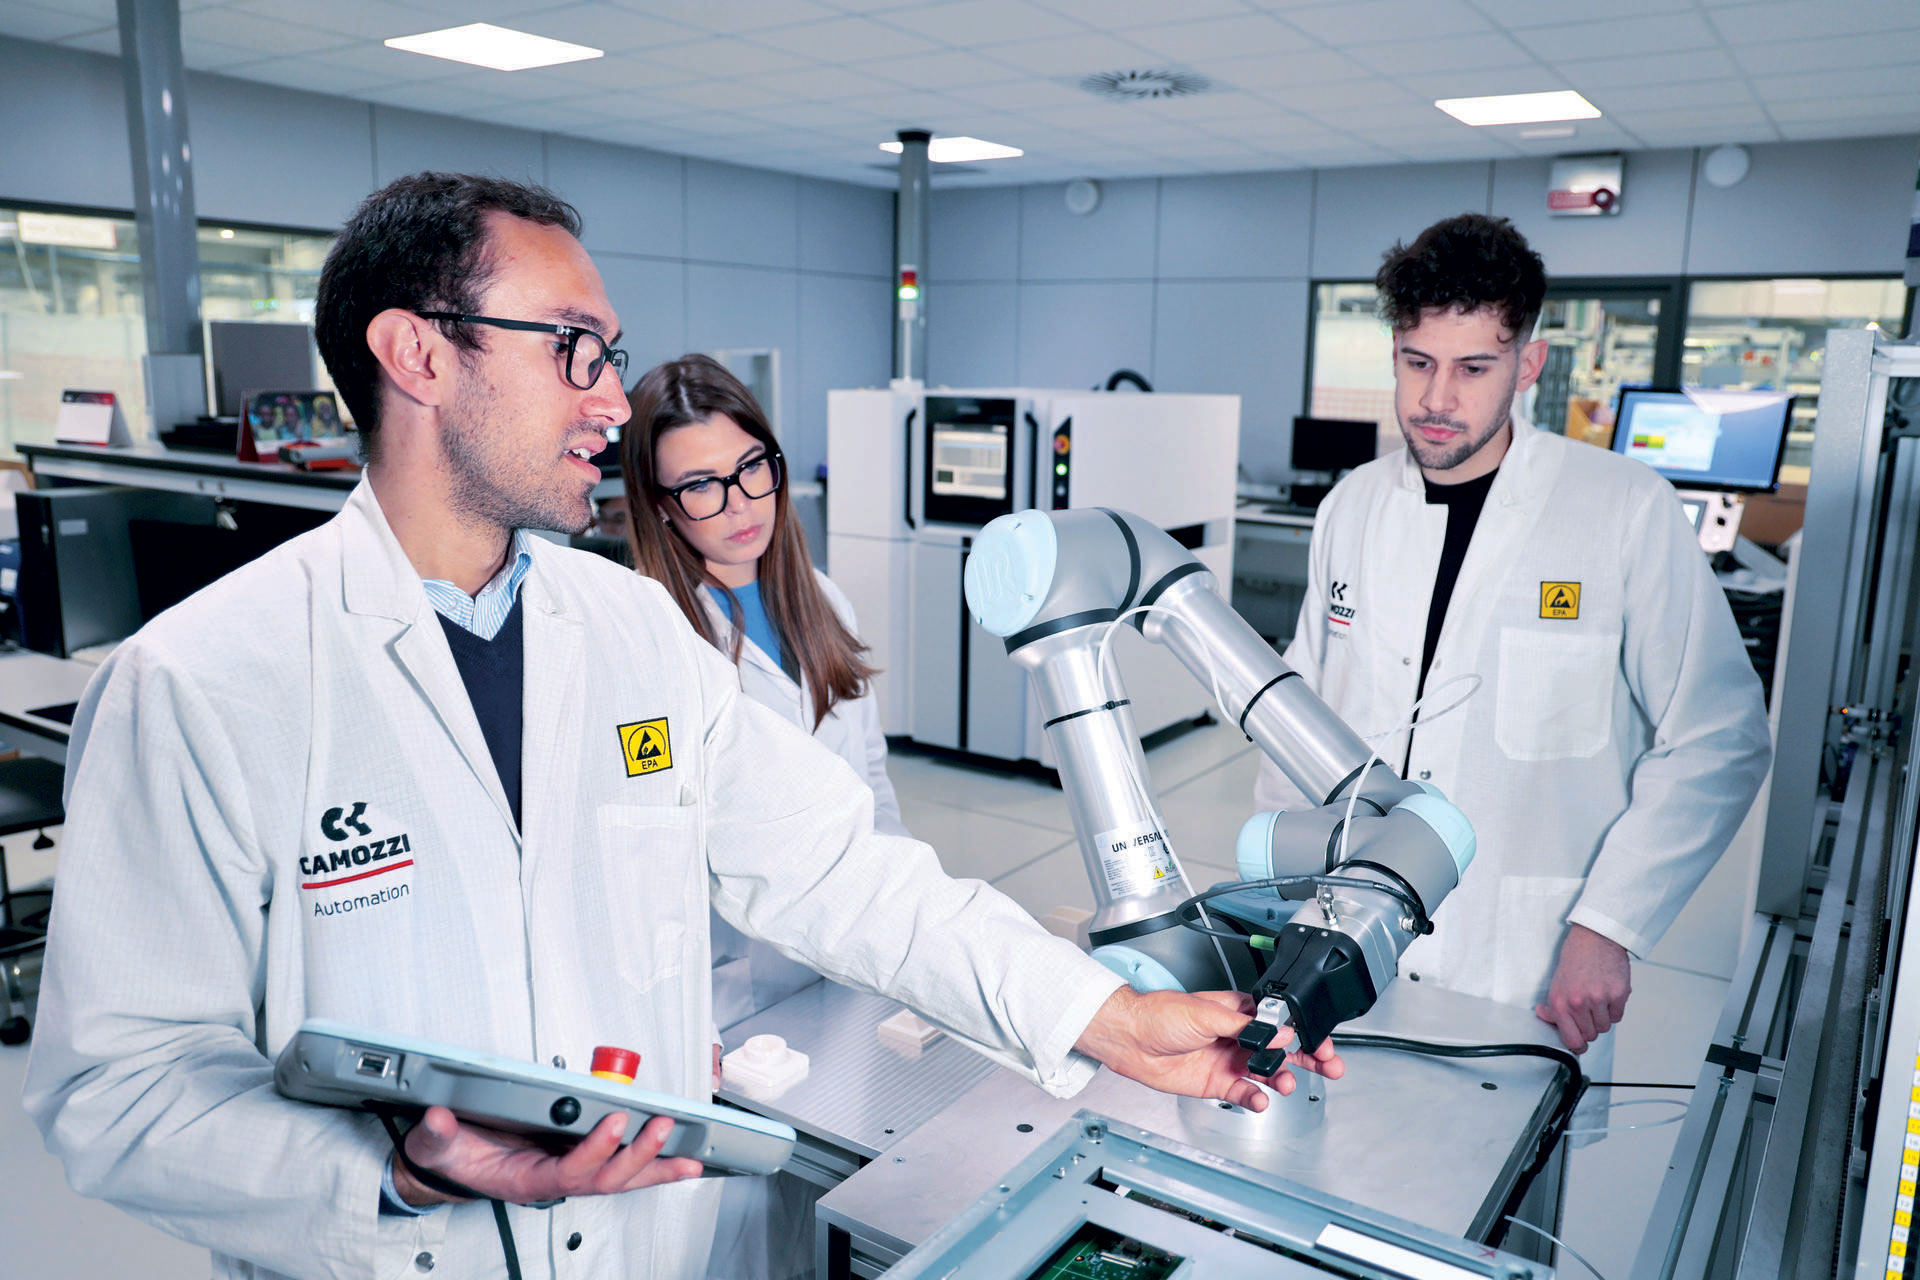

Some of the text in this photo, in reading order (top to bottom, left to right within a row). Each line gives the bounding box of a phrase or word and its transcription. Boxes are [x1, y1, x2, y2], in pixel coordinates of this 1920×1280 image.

[641, 759, 659, 770] EPA
[299, 833, 411, 875] CAMOZZI
[313, 884, 410, 917] Automation
